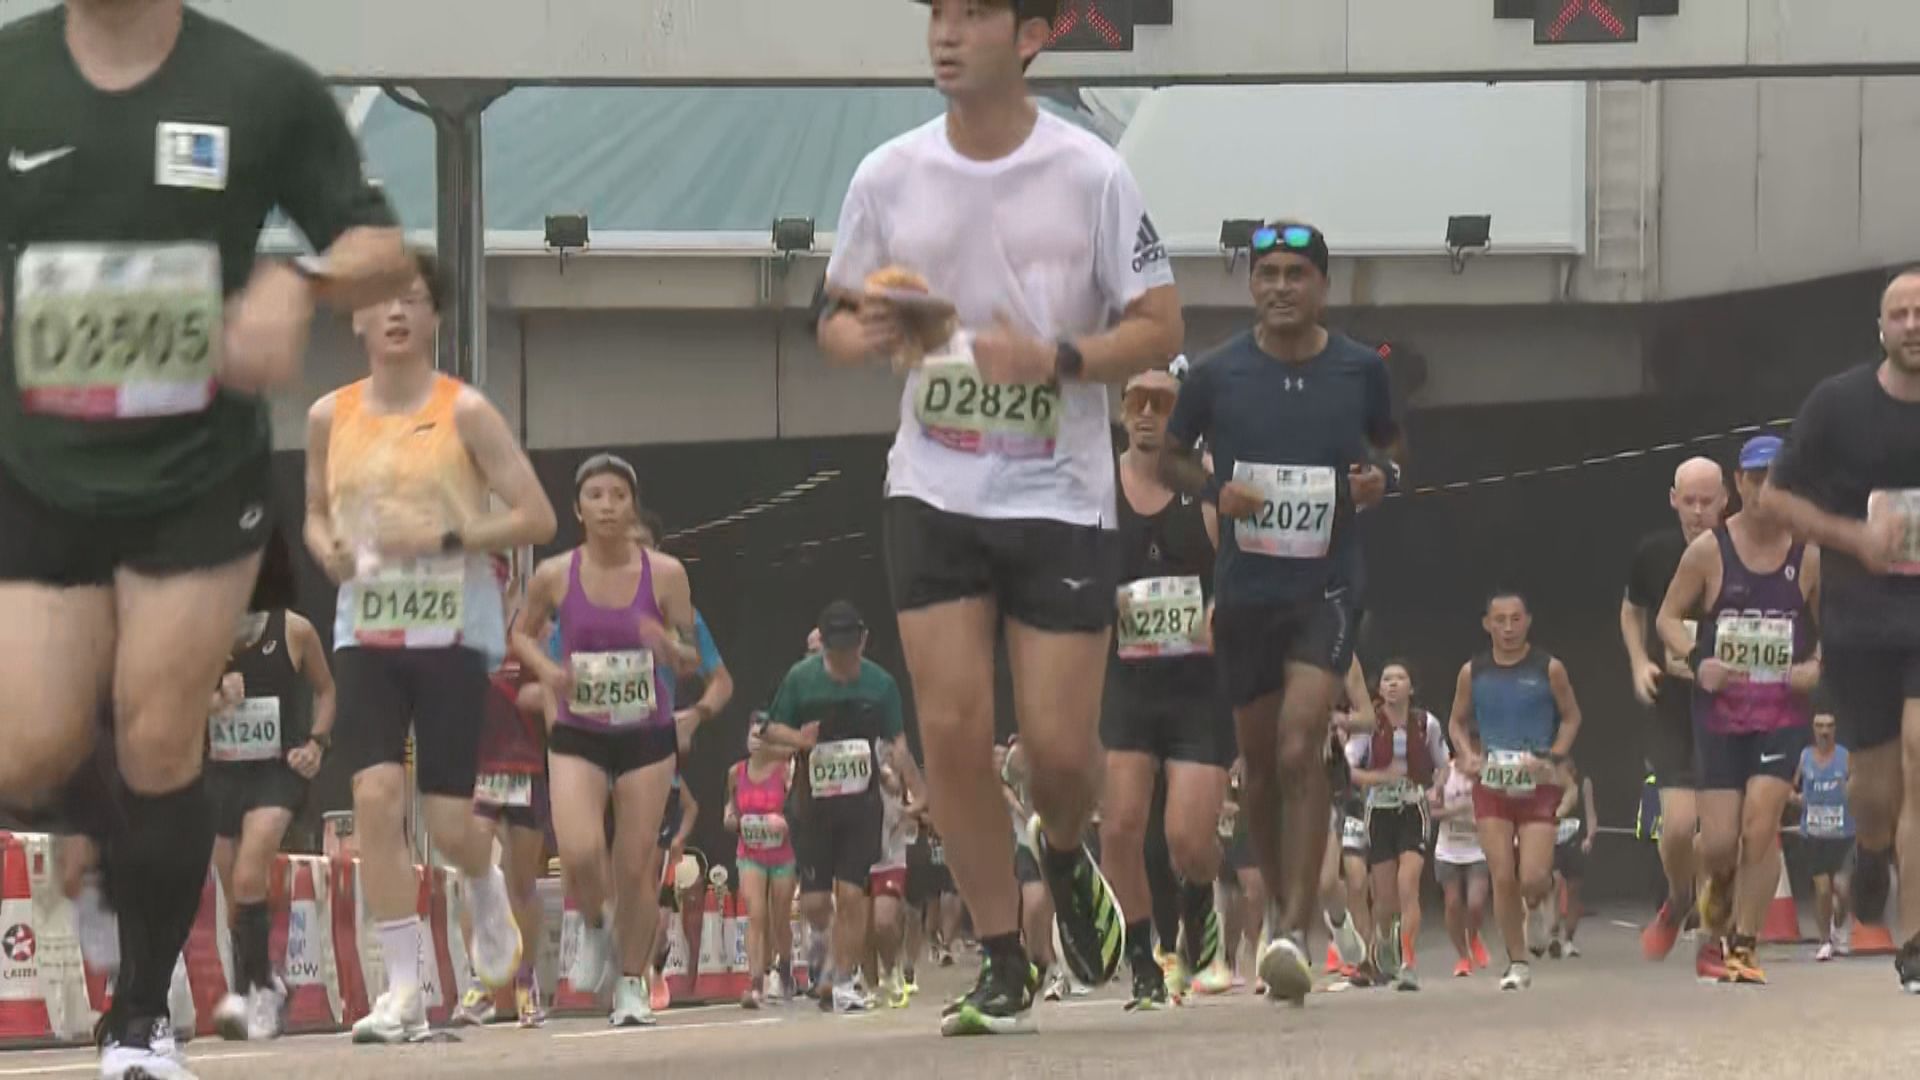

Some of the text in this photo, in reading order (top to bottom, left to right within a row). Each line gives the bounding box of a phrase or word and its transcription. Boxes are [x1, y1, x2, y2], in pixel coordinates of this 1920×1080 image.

[924, 377, 1056, 423] D2826
[1244, 499, 1329, 532] 2027
[363, 589, 457, 619] D1426
[1720, 641, 1788, 667] D2105
[577, 679, 649, 705] D2550
[214, 720, 276, 743] A1240
[814, 760, 868, 781] D2310
